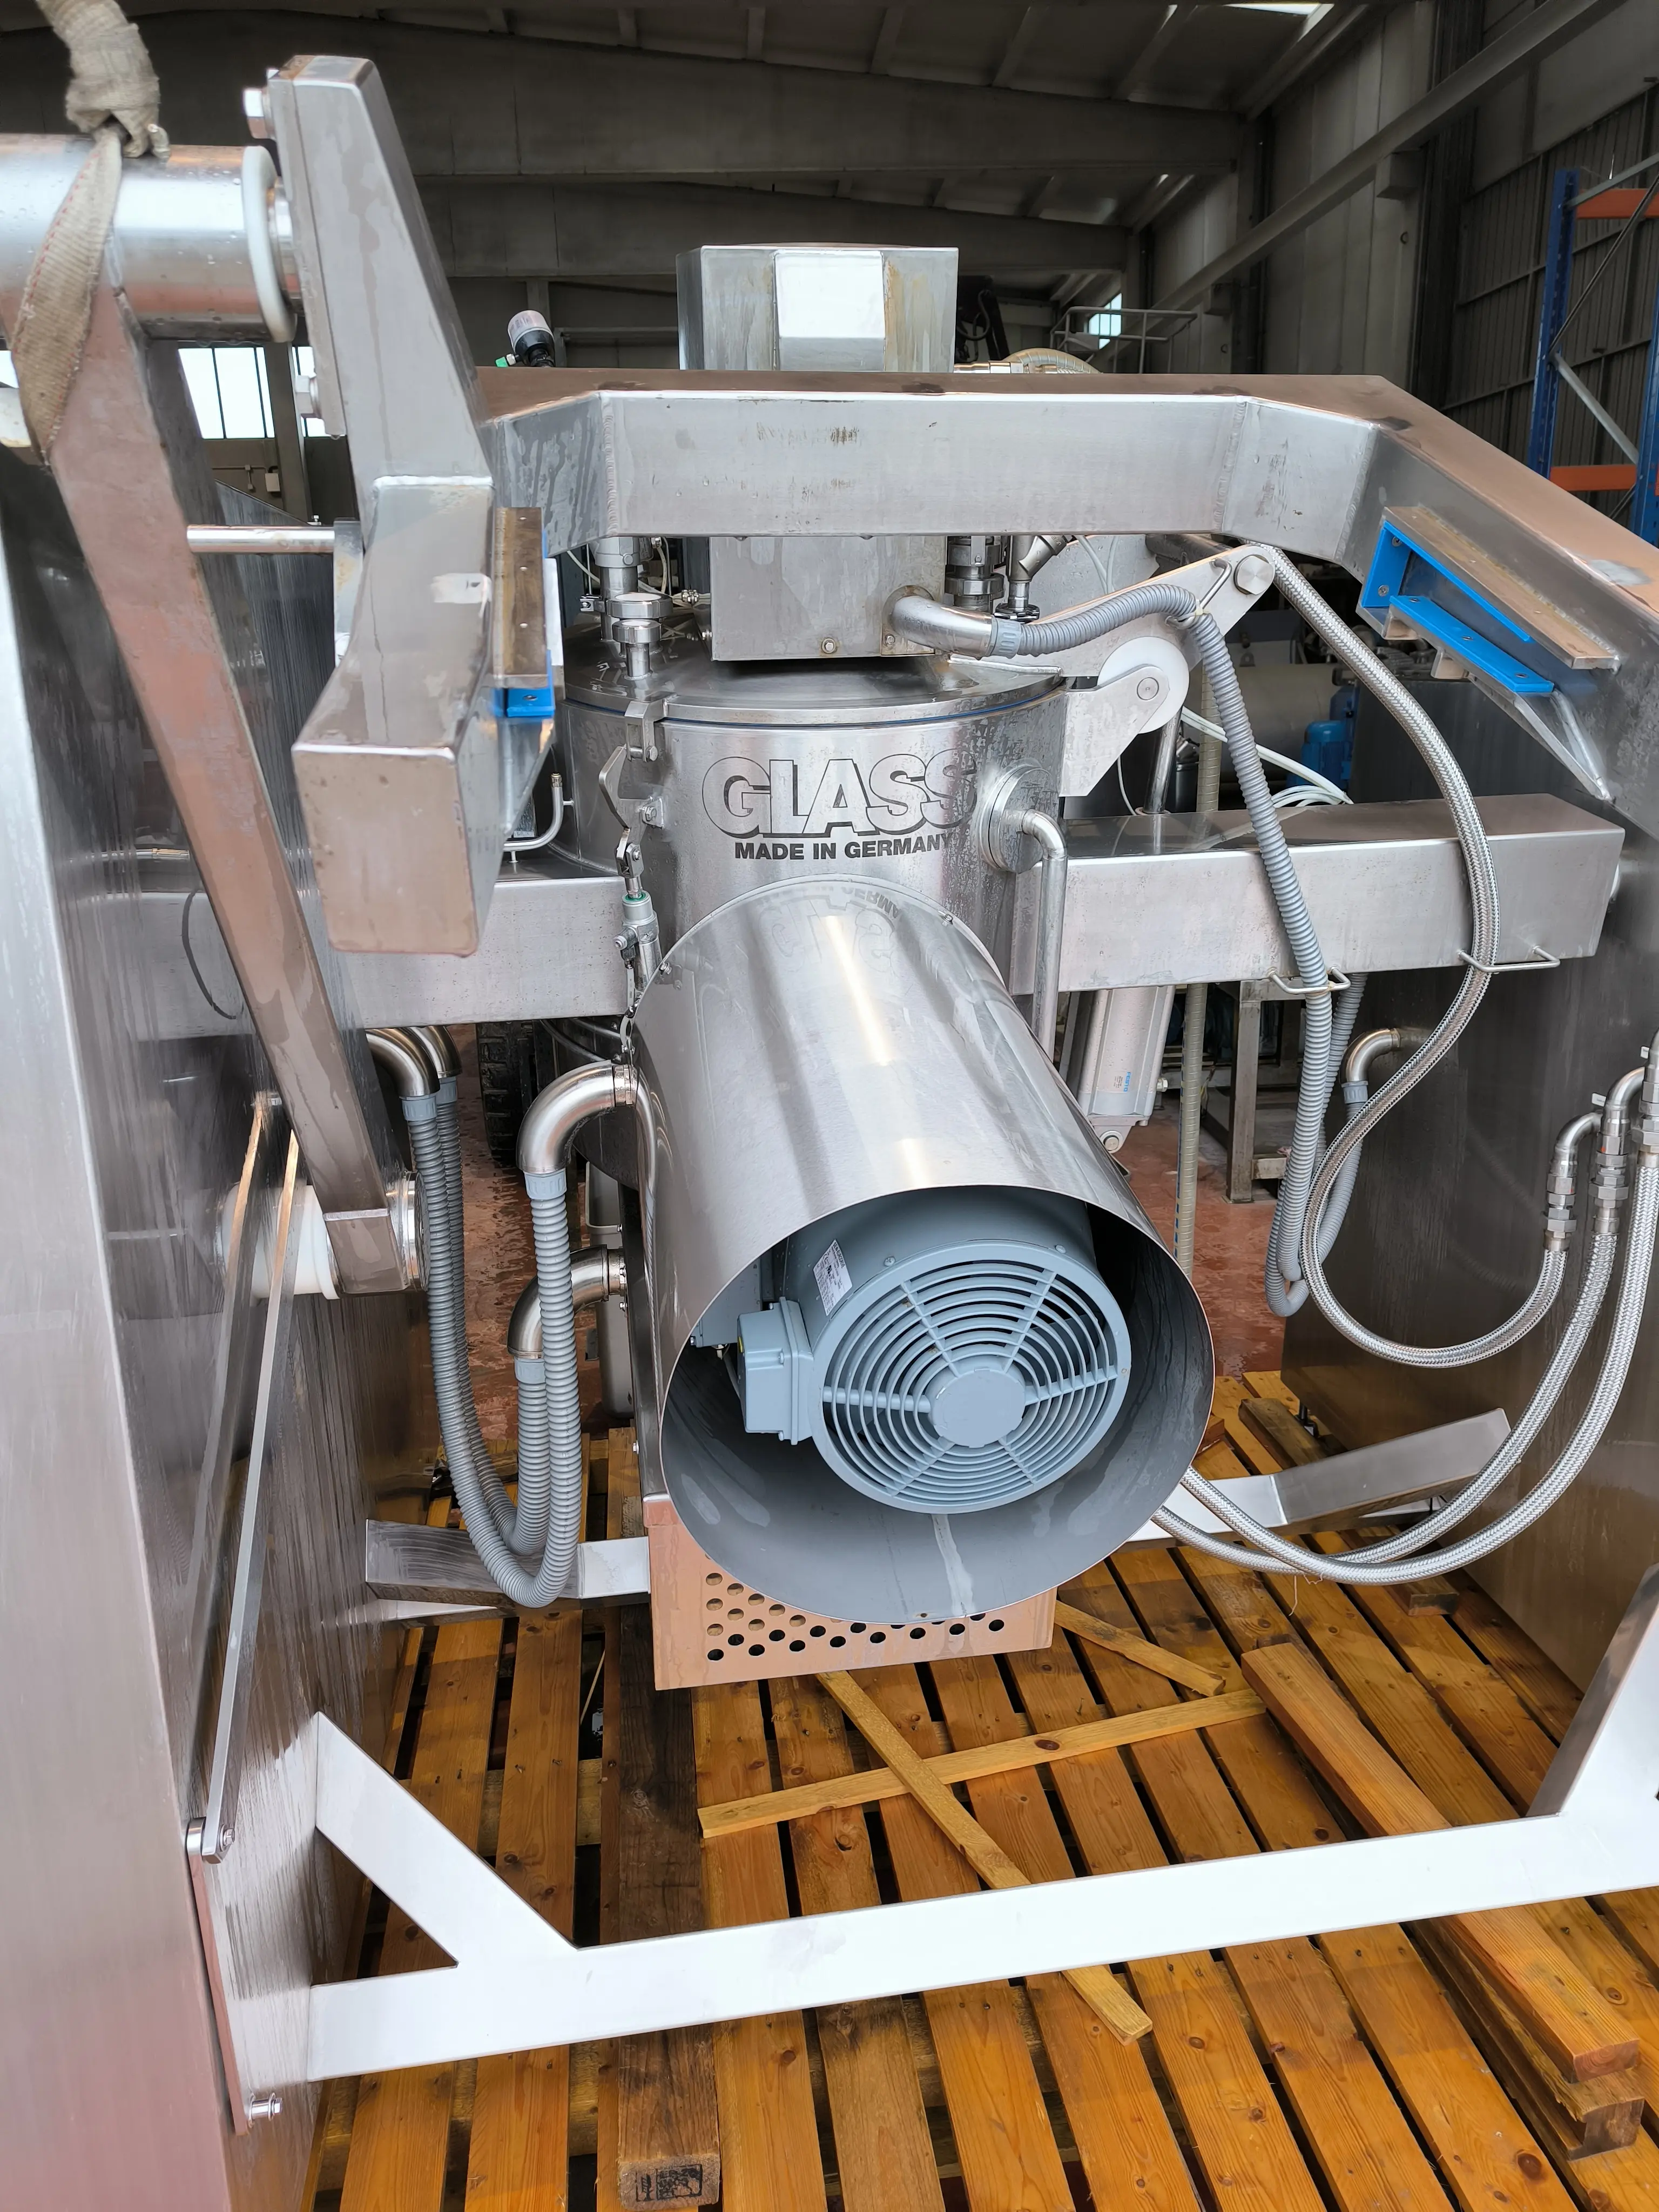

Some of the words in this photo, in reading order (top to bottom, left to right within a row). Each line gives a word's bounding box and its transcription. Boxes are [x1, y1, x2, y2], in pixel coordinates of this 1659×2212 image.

[702, 748, 976, 838] GLASS
[735, 842, 804, 860] MADE
[813, 843, 836, 860] IN
[845, 832, 953, 859] GERMANY
